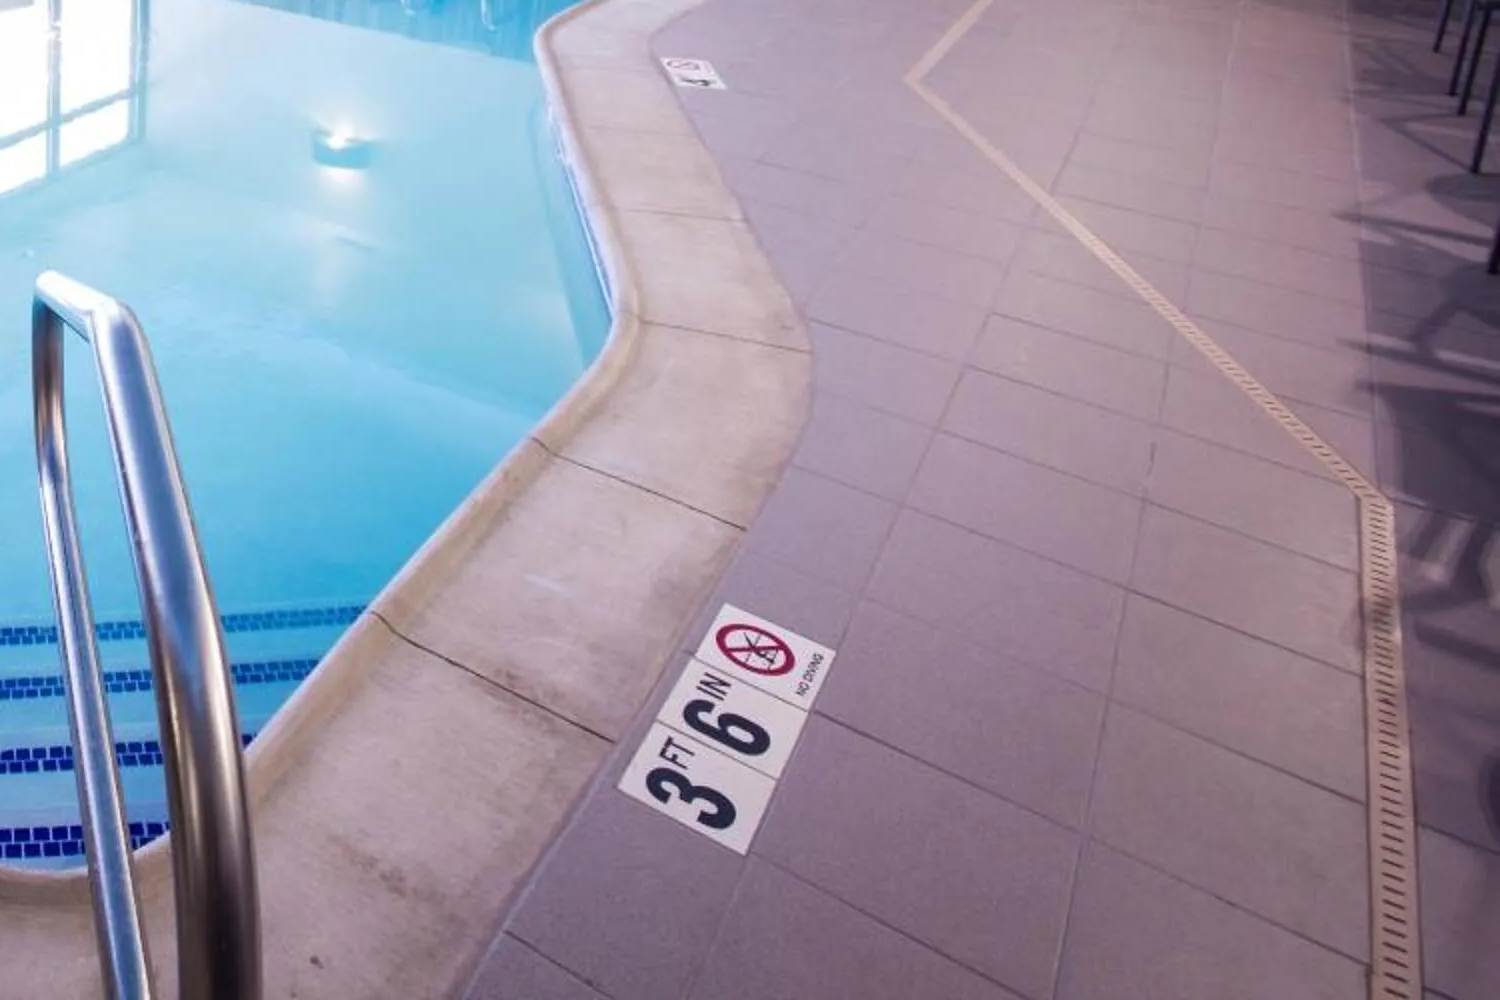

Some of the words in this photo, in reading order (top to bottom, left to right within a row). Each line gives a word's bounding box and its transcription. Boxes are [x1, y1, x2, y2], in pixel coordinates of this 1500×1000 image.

[696, 671, 733, 702] IN
[795, 681, 810, 697] NO
[803, 652, 825, 683] DIVING
[683, 699, 771, 756] 6
[657, 735, 696, 770] FT
[645, 767, 737, 830] 3
